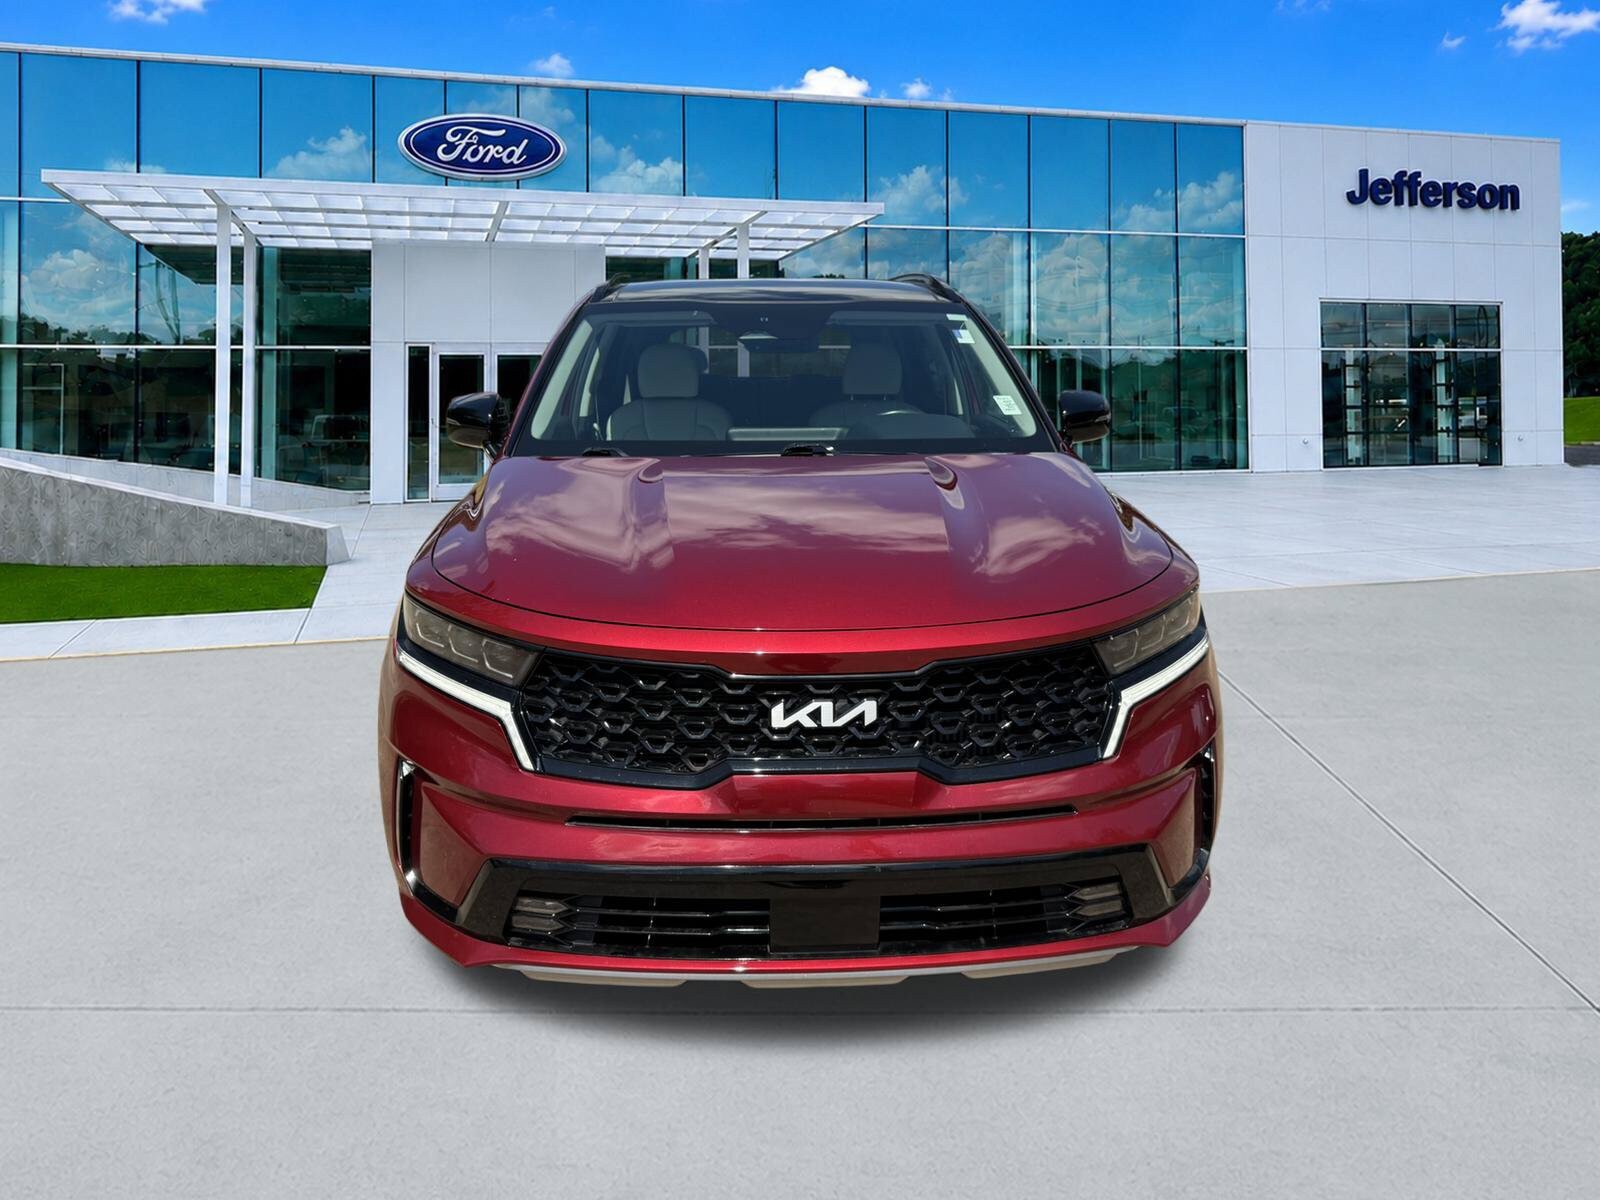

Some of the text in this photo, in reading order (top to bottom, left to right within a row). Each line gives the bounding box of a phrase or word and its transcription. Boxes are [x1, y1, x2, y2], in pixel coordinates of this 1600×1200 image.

[436, 125, 529, 165] Ford
[1346, 168, 1520, 210] Jefferson
[771, 699, 878, 728] KIA
